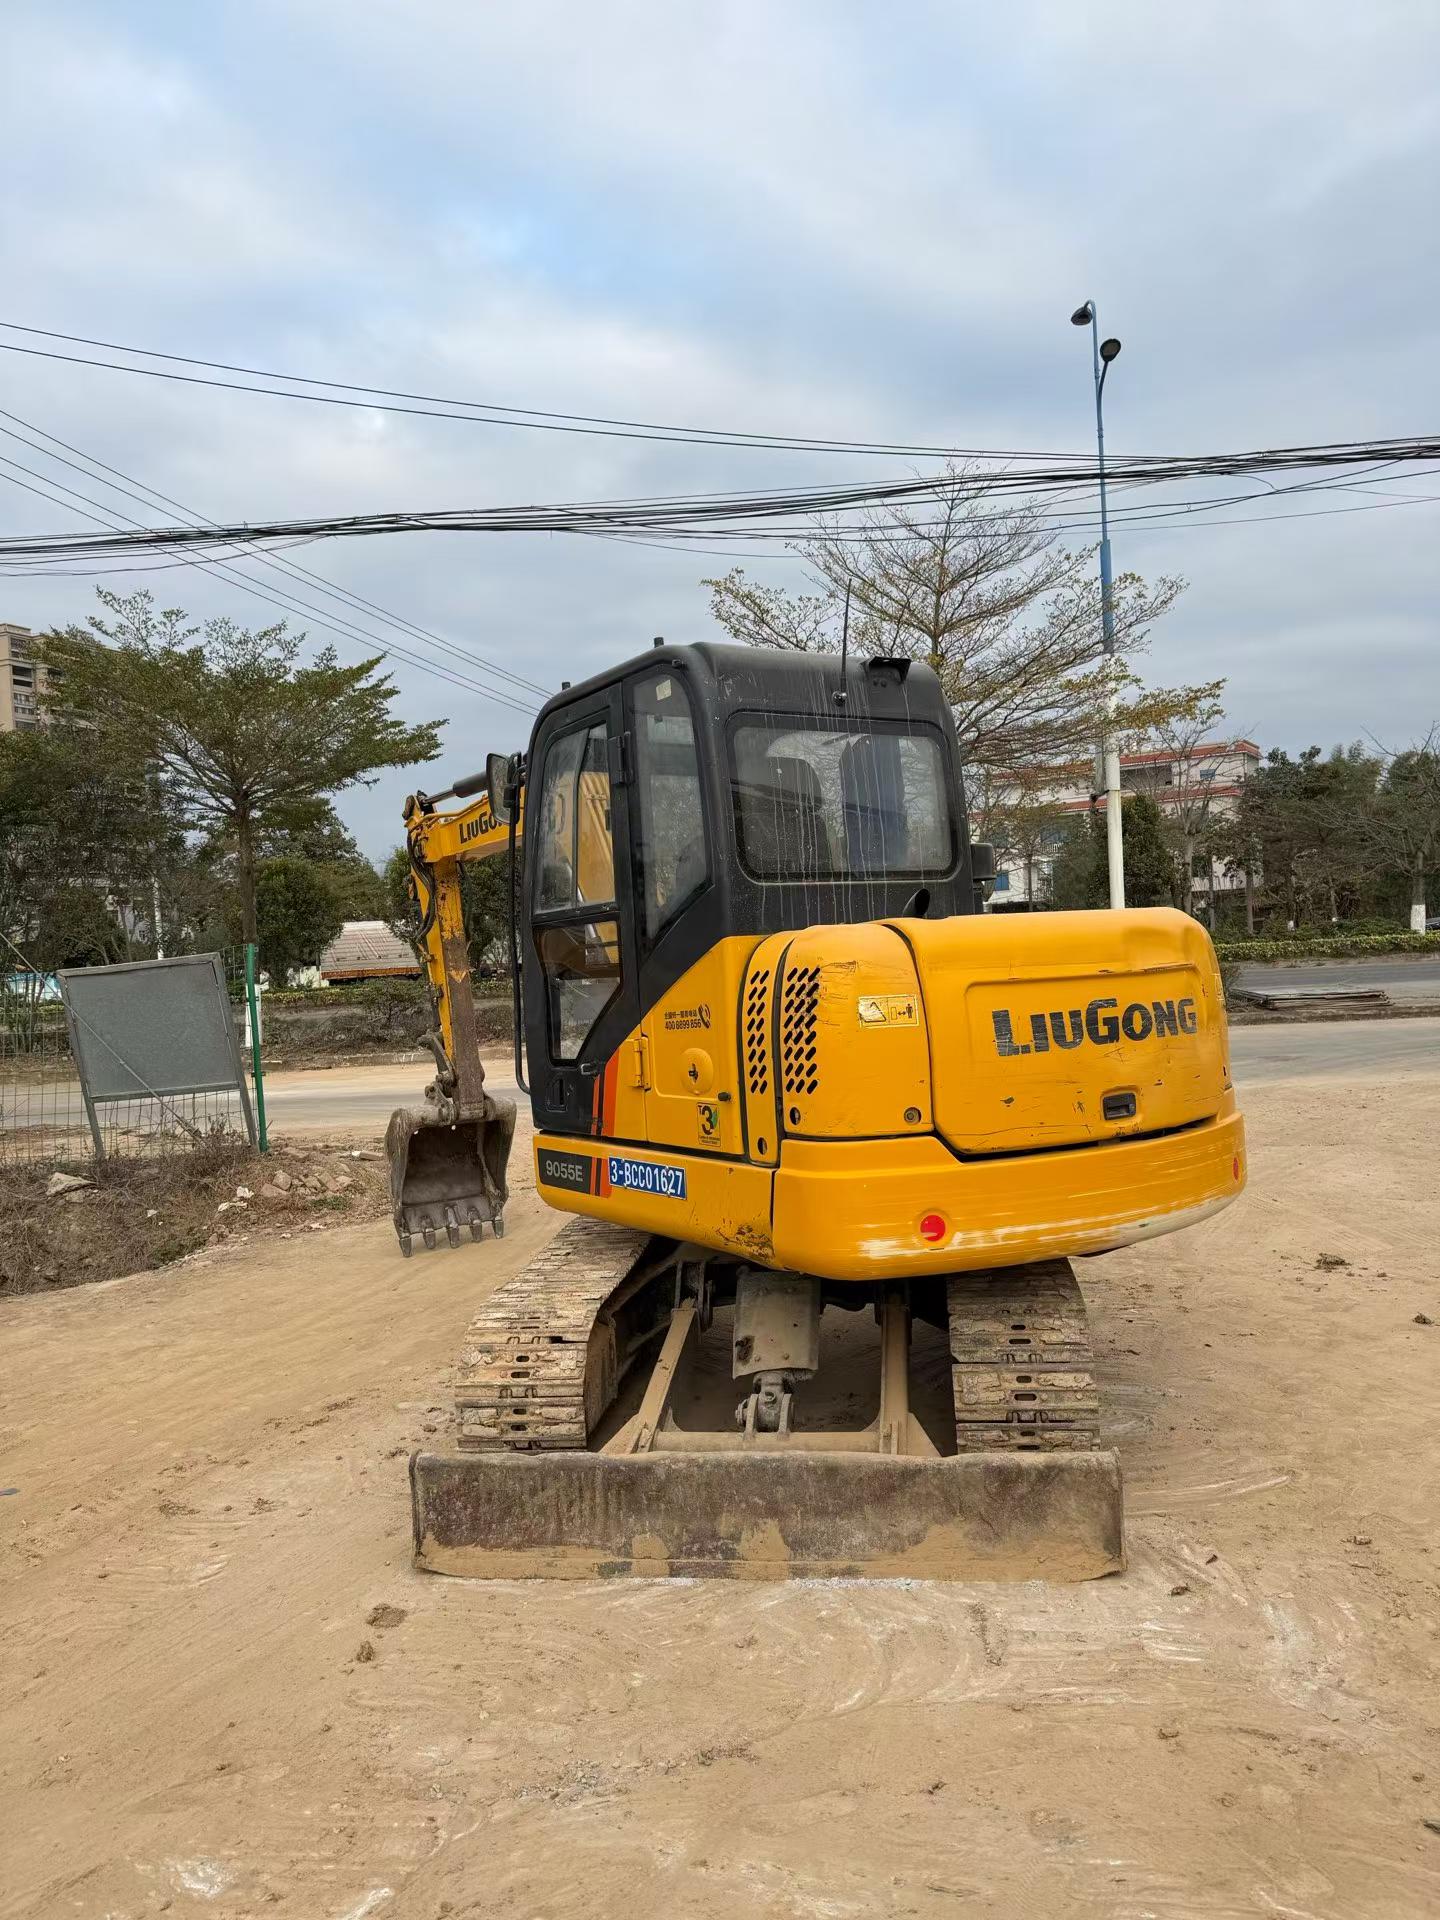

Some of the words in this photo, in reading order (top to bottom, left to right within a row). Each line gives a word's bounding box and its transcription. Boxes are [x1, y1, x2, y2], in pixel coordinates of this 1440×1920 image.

[459, 810, 502, 844] LIUGO
[992, 998, 1197, 1057] LIUGONG
[545, 1160, 584, 1182] 9055E
[610, 1160, 683, 1196] 3-BCC01627
